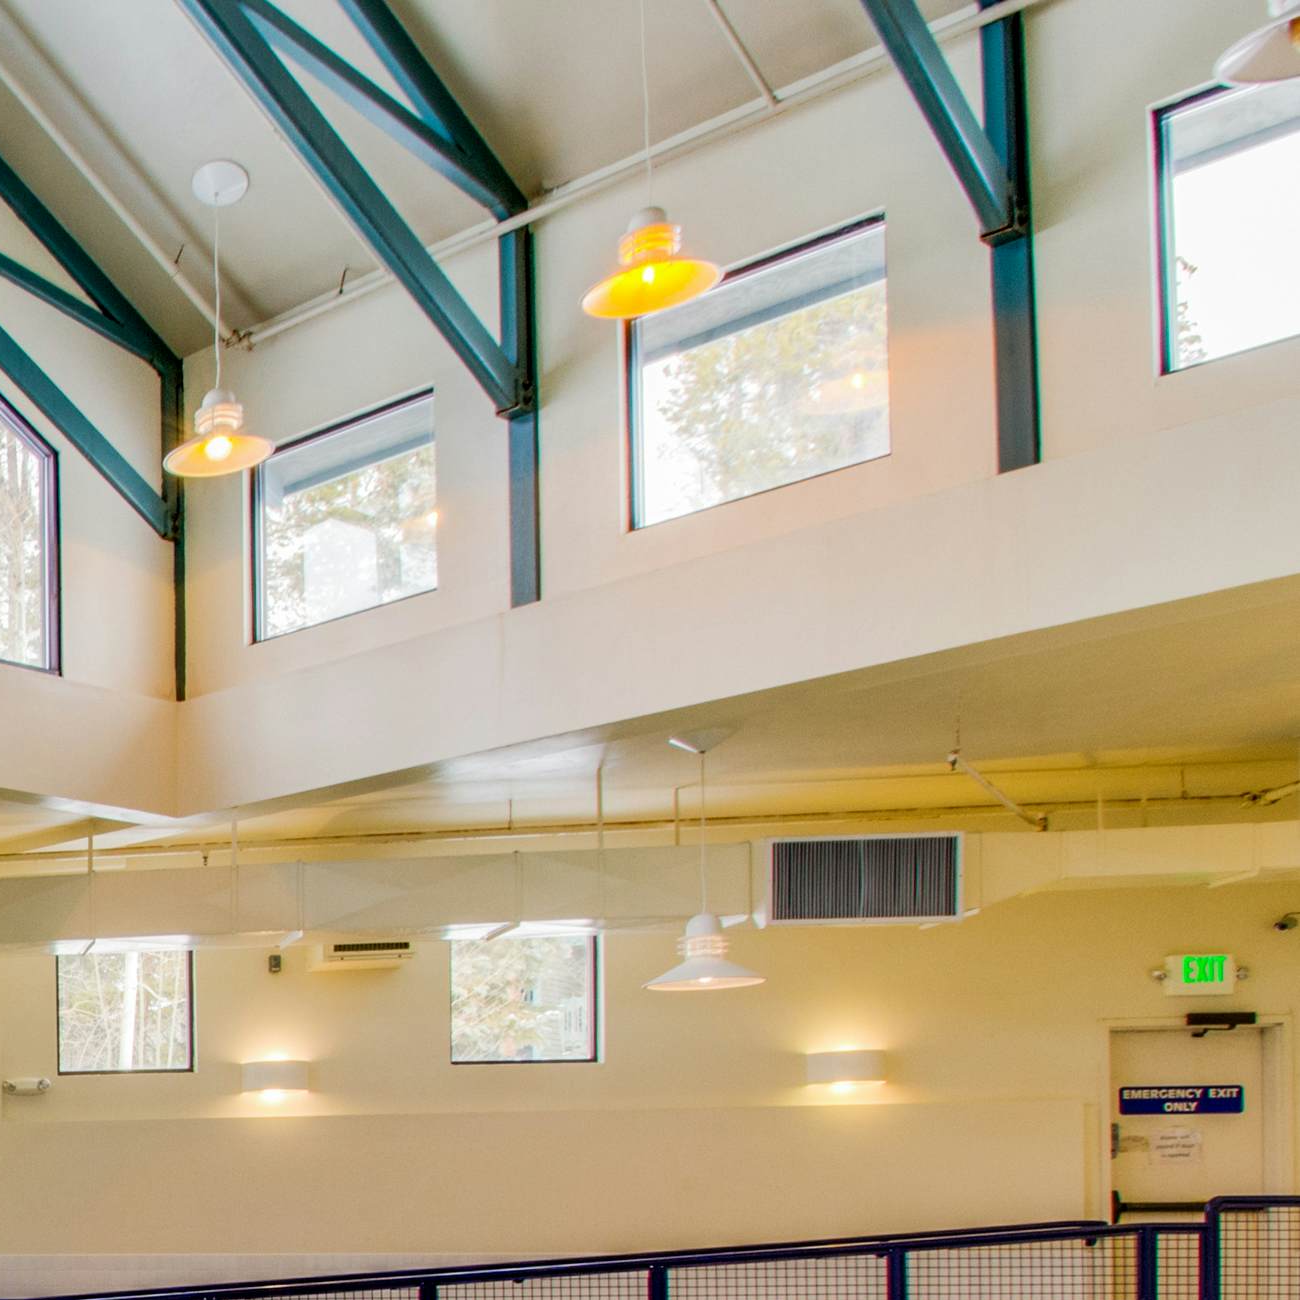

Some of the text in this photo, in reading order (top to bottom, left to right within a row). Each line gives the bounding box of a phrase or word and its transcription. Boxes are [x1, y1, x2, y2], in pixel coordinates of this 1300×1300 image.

[1183, 955, 1227, 983] EXIT
[1122, 1087, 1240, 1100] EMERGENCY EXIT
[1163, 1102, 1198, 1112] ONLY
